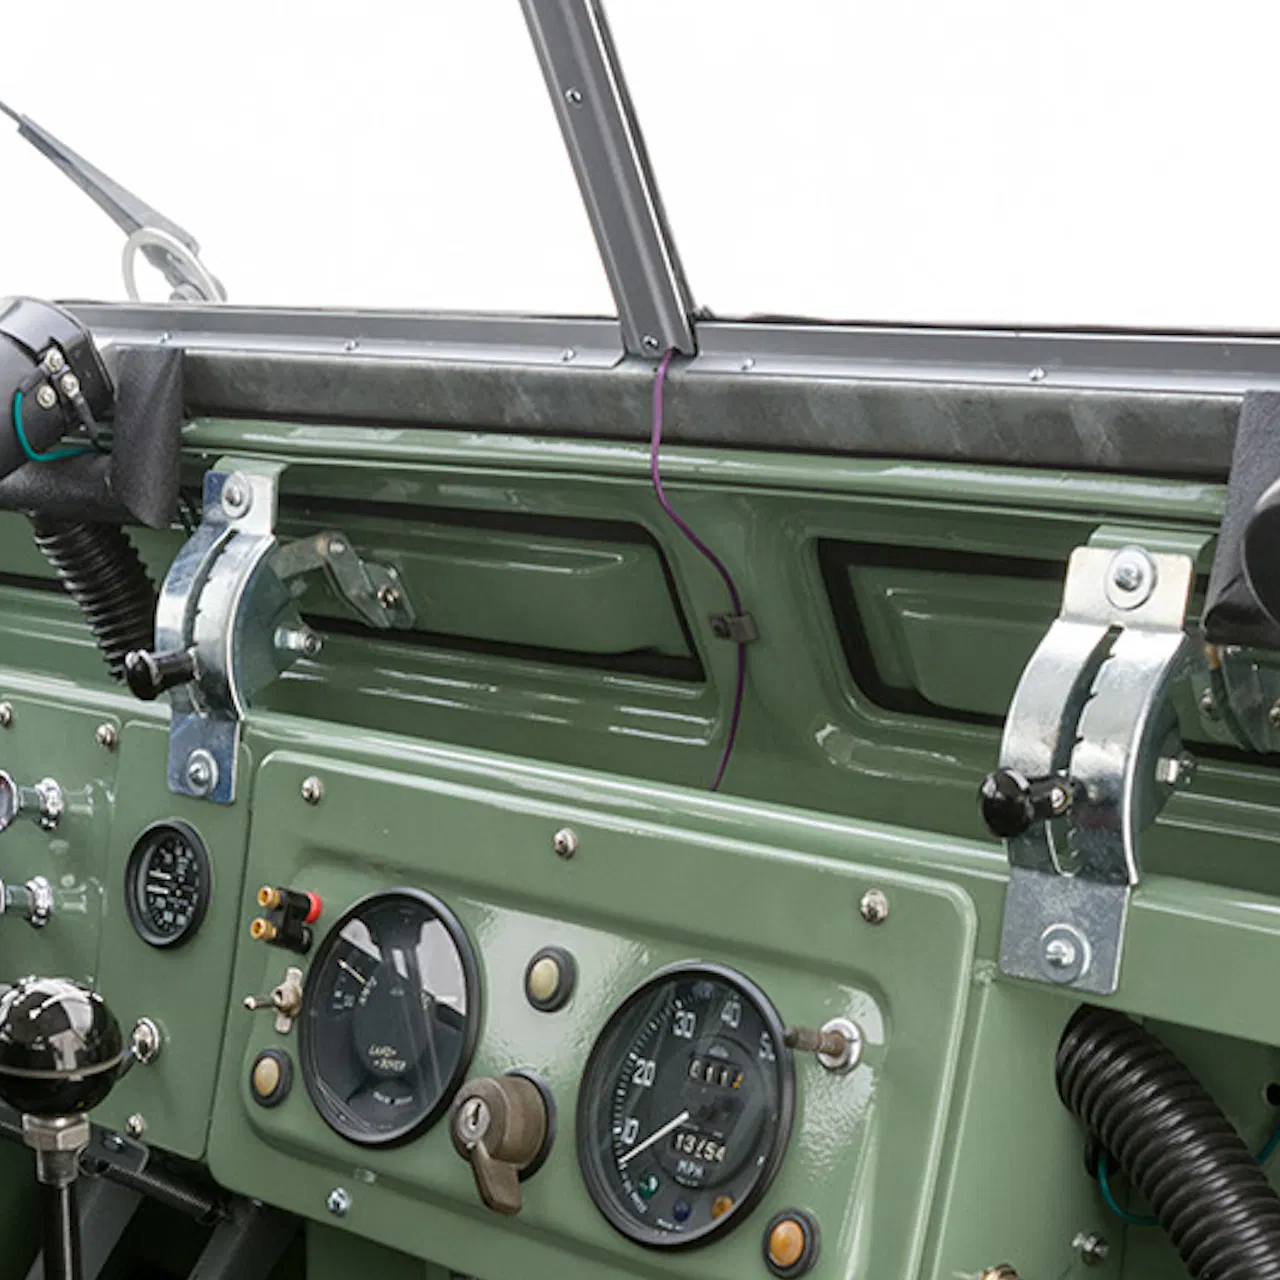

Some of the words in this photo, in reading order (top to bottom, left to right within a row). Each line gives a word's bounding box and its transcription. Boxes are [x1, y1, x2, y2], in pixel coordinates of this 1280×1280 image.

[673, 1010, 696, 1039] 30
[721, 1001, 742, 1029] 40
[632, 1058, 656, 1087] 20
